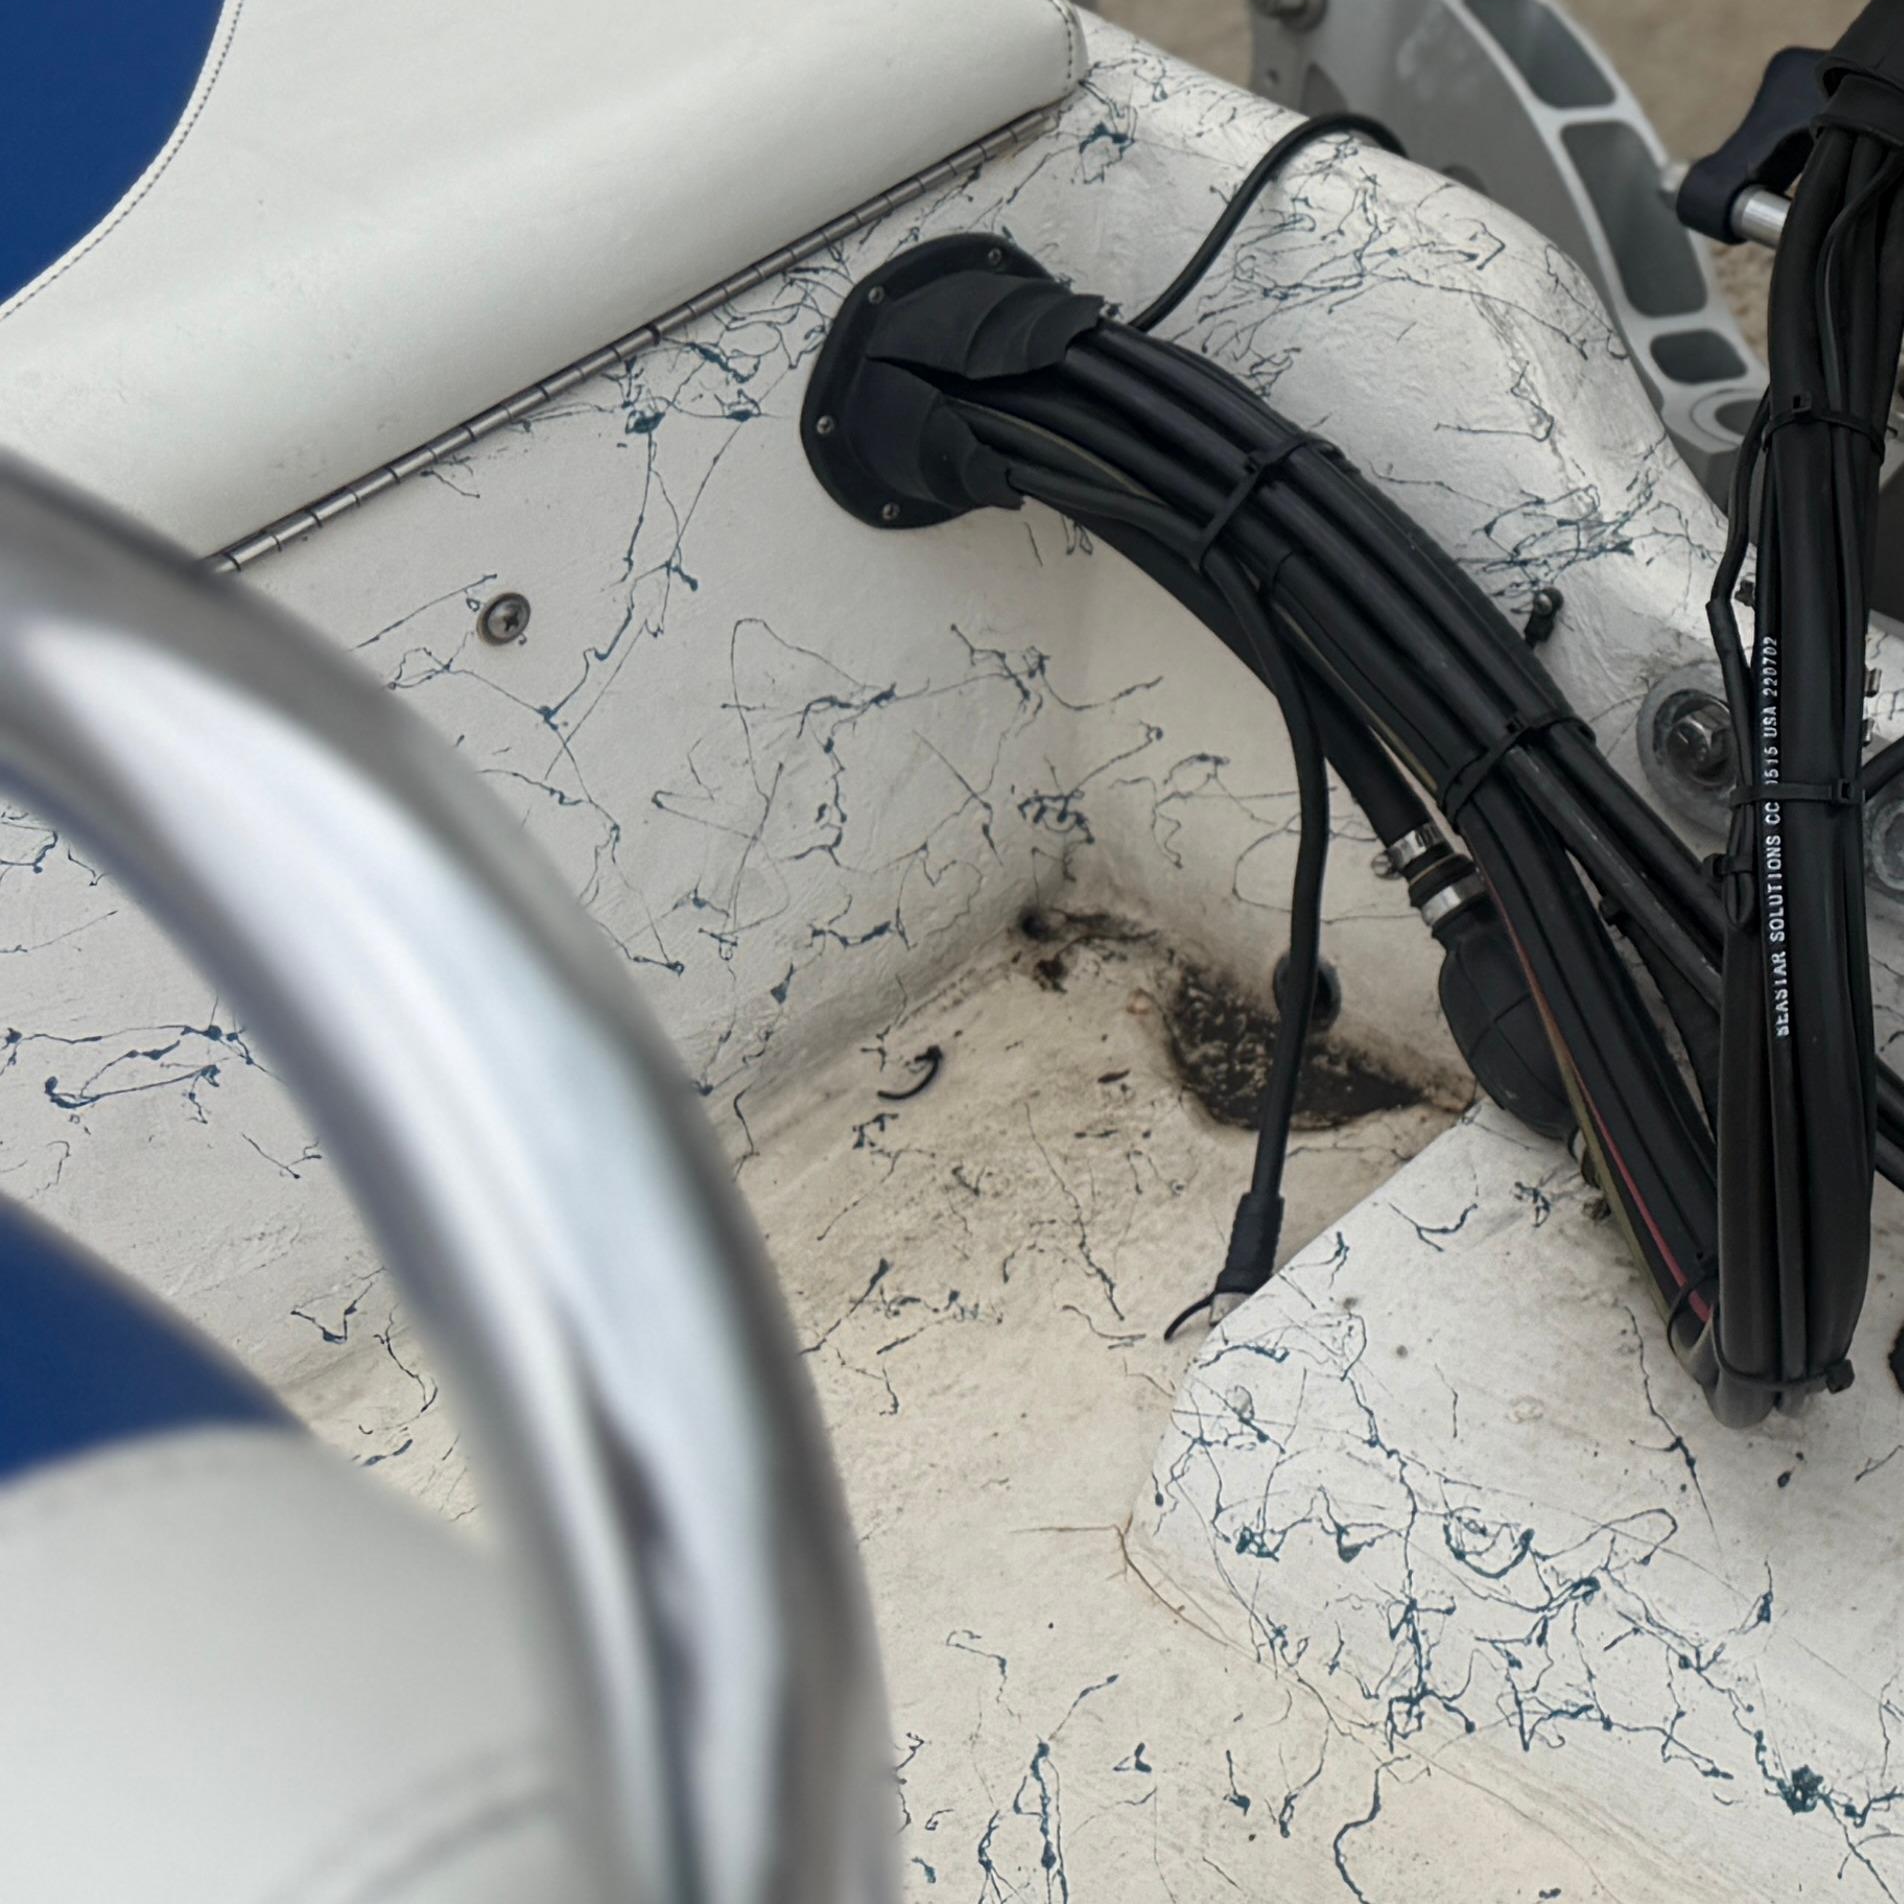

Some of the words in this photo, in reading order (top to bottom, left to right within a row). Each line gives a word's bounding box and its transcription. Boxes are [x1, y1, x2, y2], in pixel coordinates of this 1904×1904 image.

[1762, 636, 1778, 697] 220702
[1763, 706, 1778, 737] USA
[1765, 835, 1786, 943] SOLUTIONS
